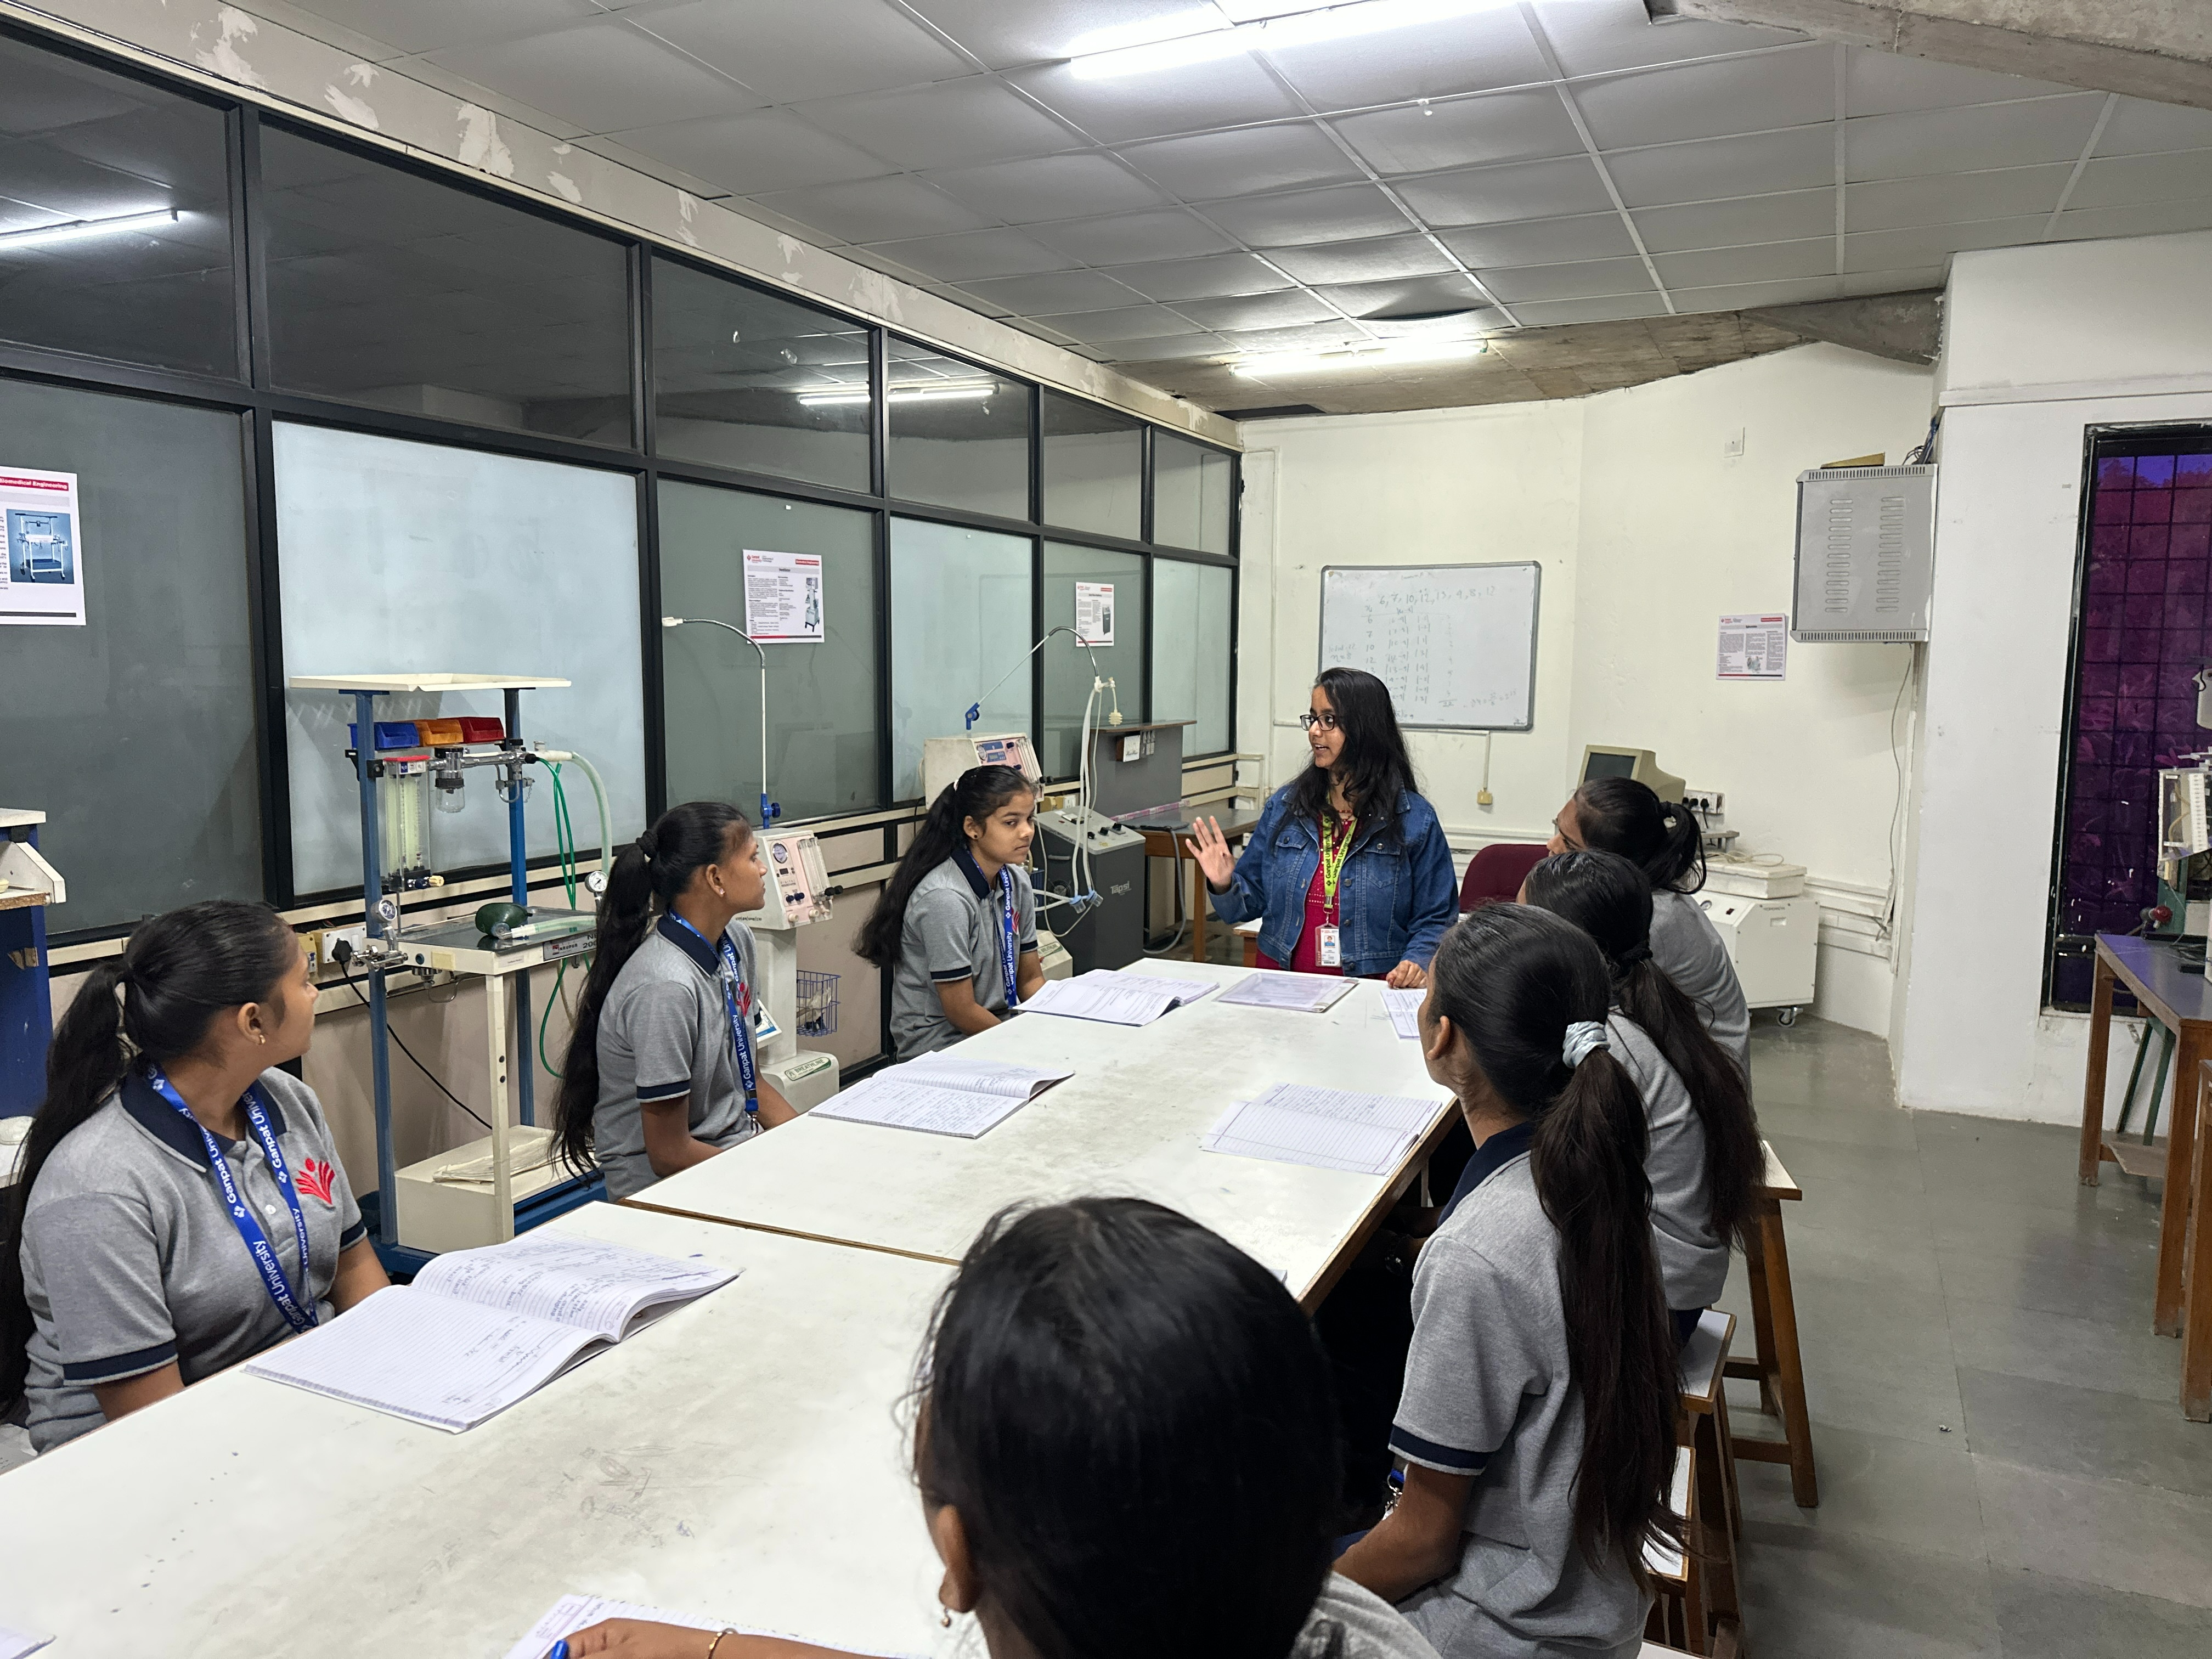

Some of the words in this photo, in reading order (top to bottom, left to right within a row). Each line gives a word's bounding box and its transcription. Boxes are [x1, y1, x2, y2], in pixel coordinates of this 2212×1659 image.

[1333, 857, 1342, 878] Ganpat
[1338, 833, 1352, 857] University
[732, 1014, 745, 1052] University
[739, 1051, 751, 1080] Ganpat
[794, 1059, 825, 1073] BREATHLINE
[259, 1125, 282, 1169] Ganpat
[215, 1158, 237, 1204] Ganpat
[253, 1240, 285, 1295] University
[277, 1294, 306, 1325] Ganpat
